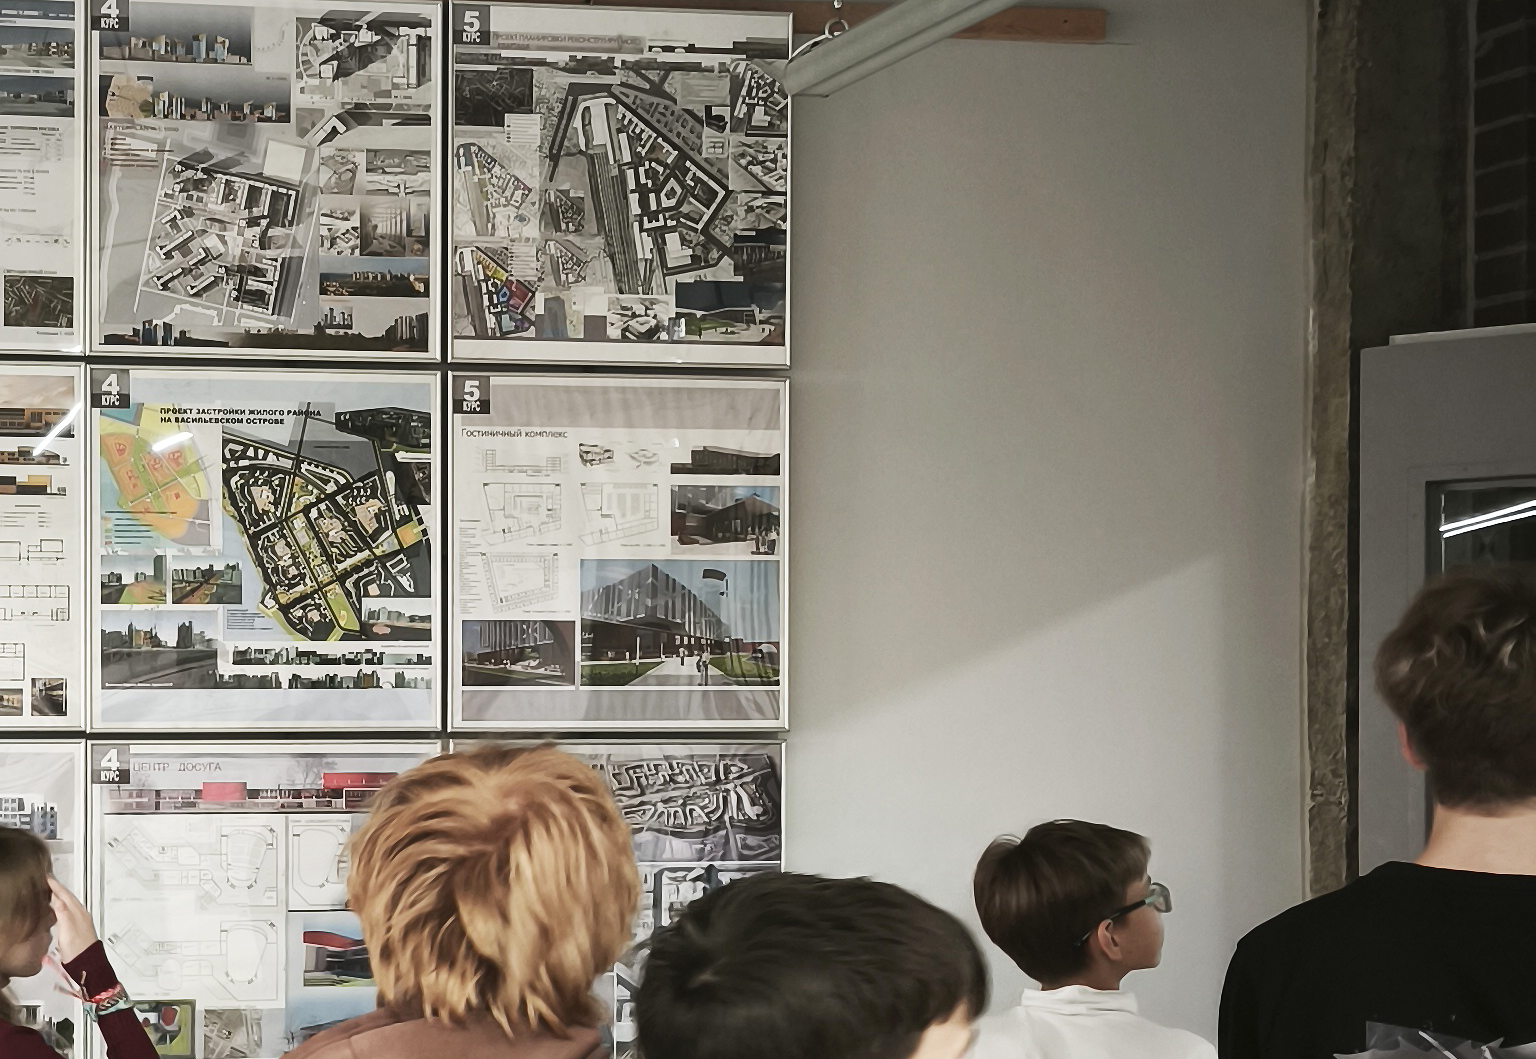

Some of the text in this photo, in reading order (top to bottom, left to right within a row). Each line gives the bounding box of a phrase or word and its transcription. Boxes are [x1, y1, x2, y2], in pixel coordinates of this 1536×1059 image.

[100, 0, 120, 17] 4
[100, 18, 119, 29] КУРС
[463, 10, 481, 32] 5
[462, 32, 481, 43] КУРС
[101, 373, 120, 395] 4
[463, 380, 480, 401] 5
[101, 394, 120, 406] КУРС
[462, 401, 481, 412] КУРС
[159, 407, 322, 418] ПРОЕКТ ЗАСТРОЙКИ ЖИЛОГО РАЙОНА
[174, 417, 244, 426] ВАСИЛЬЕВСКОМ
[461, 428, 568, 439] Гостиничный комплекс
[100, 748, 120, 771] 4
[133, 762, 222, 772] ЦЕНТР ДОСУГА
[100, 770, 120, 781] КУРС
